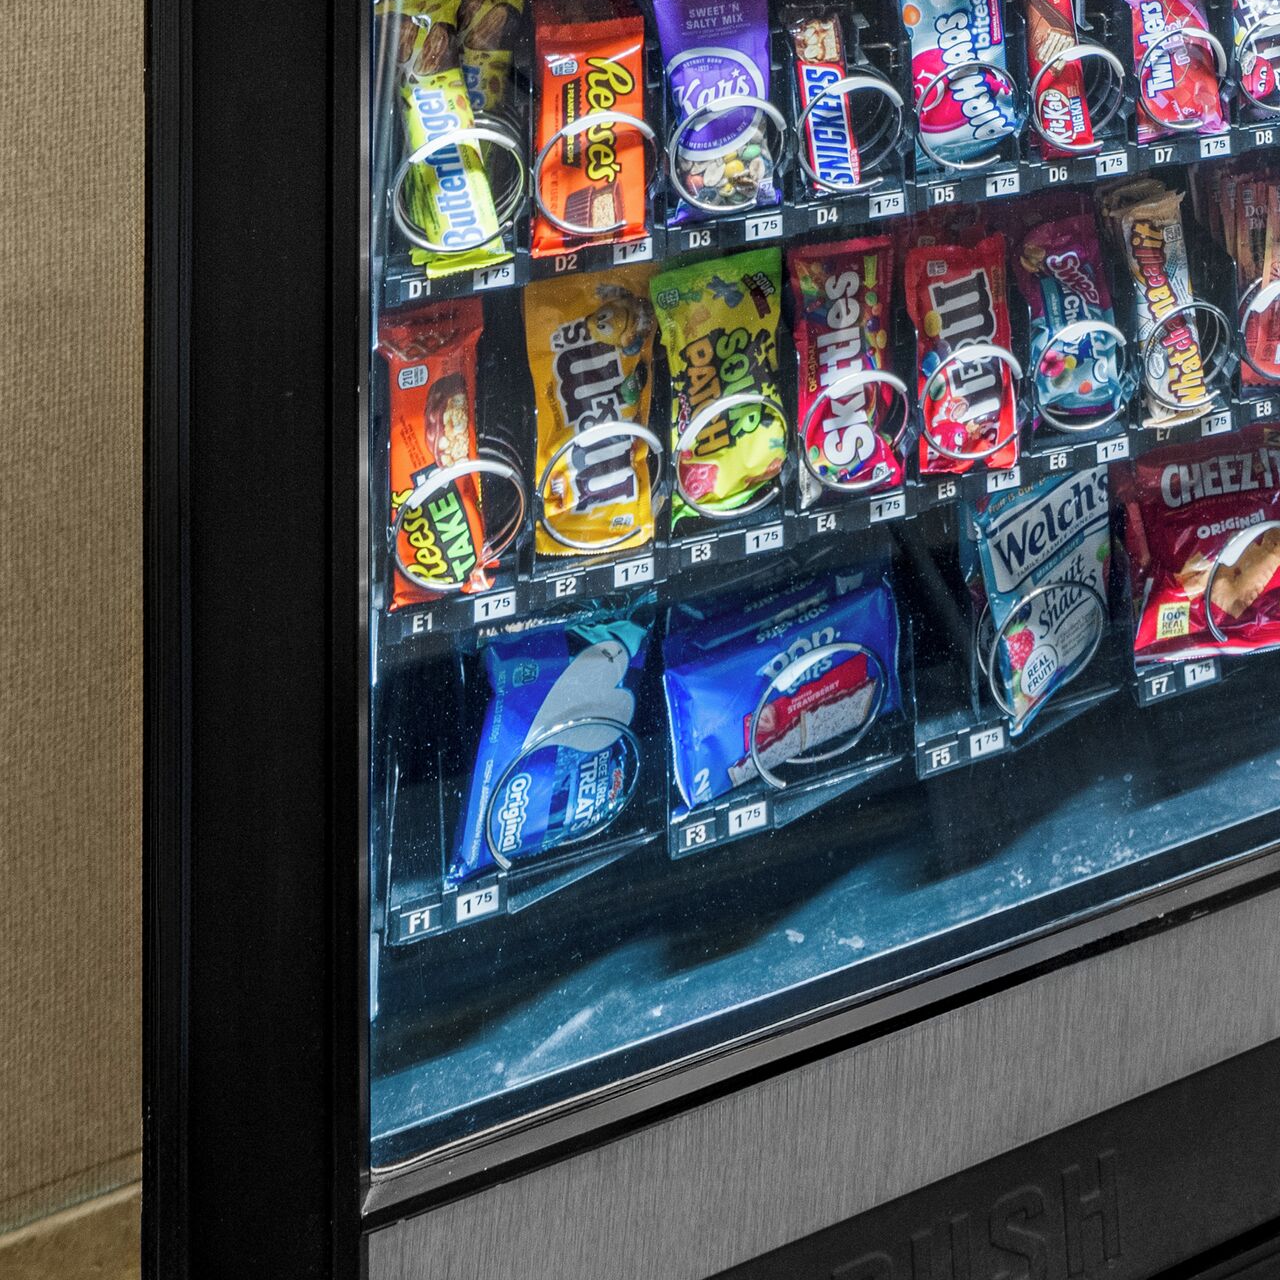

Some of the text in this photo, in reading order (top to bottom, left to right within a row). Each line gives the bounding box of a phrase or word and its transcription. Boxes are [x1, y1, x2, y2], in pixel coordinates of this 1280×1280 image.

[686, 13, 743, 30] SALTY MIX
[688, 5, 725, 19] SWEET
[674, 74, 751, 118] Kar's
[1255, 129, 1273, 146] D8
[1154, 148, 1173, 163] D7
[1049, 165, 1068, 182] D6
[934, 186, 955, 203] D5
[816, 207, 839, 225] D4
[689, 230, 712, 248] D3
[555, 253, 578, 272] D2
[408, 279, 432, 298] D1
[752, 272, 776, 296] SOUR
[1256, 401, 1273, 417] E8
[1050, 453, 1068, 470] E6
[937, 482, 956, 500] E5
[817, 514, 837, 532] E4
[994, 470, 1109, 576] Welch's
[429, 491, 478, 582] TAKE
[691, 544, 712, 563] E3
[555, 578, 577, 597] E2
[1043, 553, 1084, 609] Fruit
[1039, 569, 1098, 639] Snacks
[412, 613, 434, 632] E1
[1161, 621, 1184, 630] REAL
[1027, 654, 1050, 679] REAL
[1027, 660, 1056, 694] FRUIT!
[787, 680, 840, 714] STRAWBERRY
[1152, 679, 1169, 696] F7
[931, 746, 951, 767] F5
[693, 768, 710, 797] 2
[571, 756, 601, 833] TREATS
[499, 771, 532, 853] Original
[685, 825, 707, 845] F3
[408, 913, 431, 933] F1
